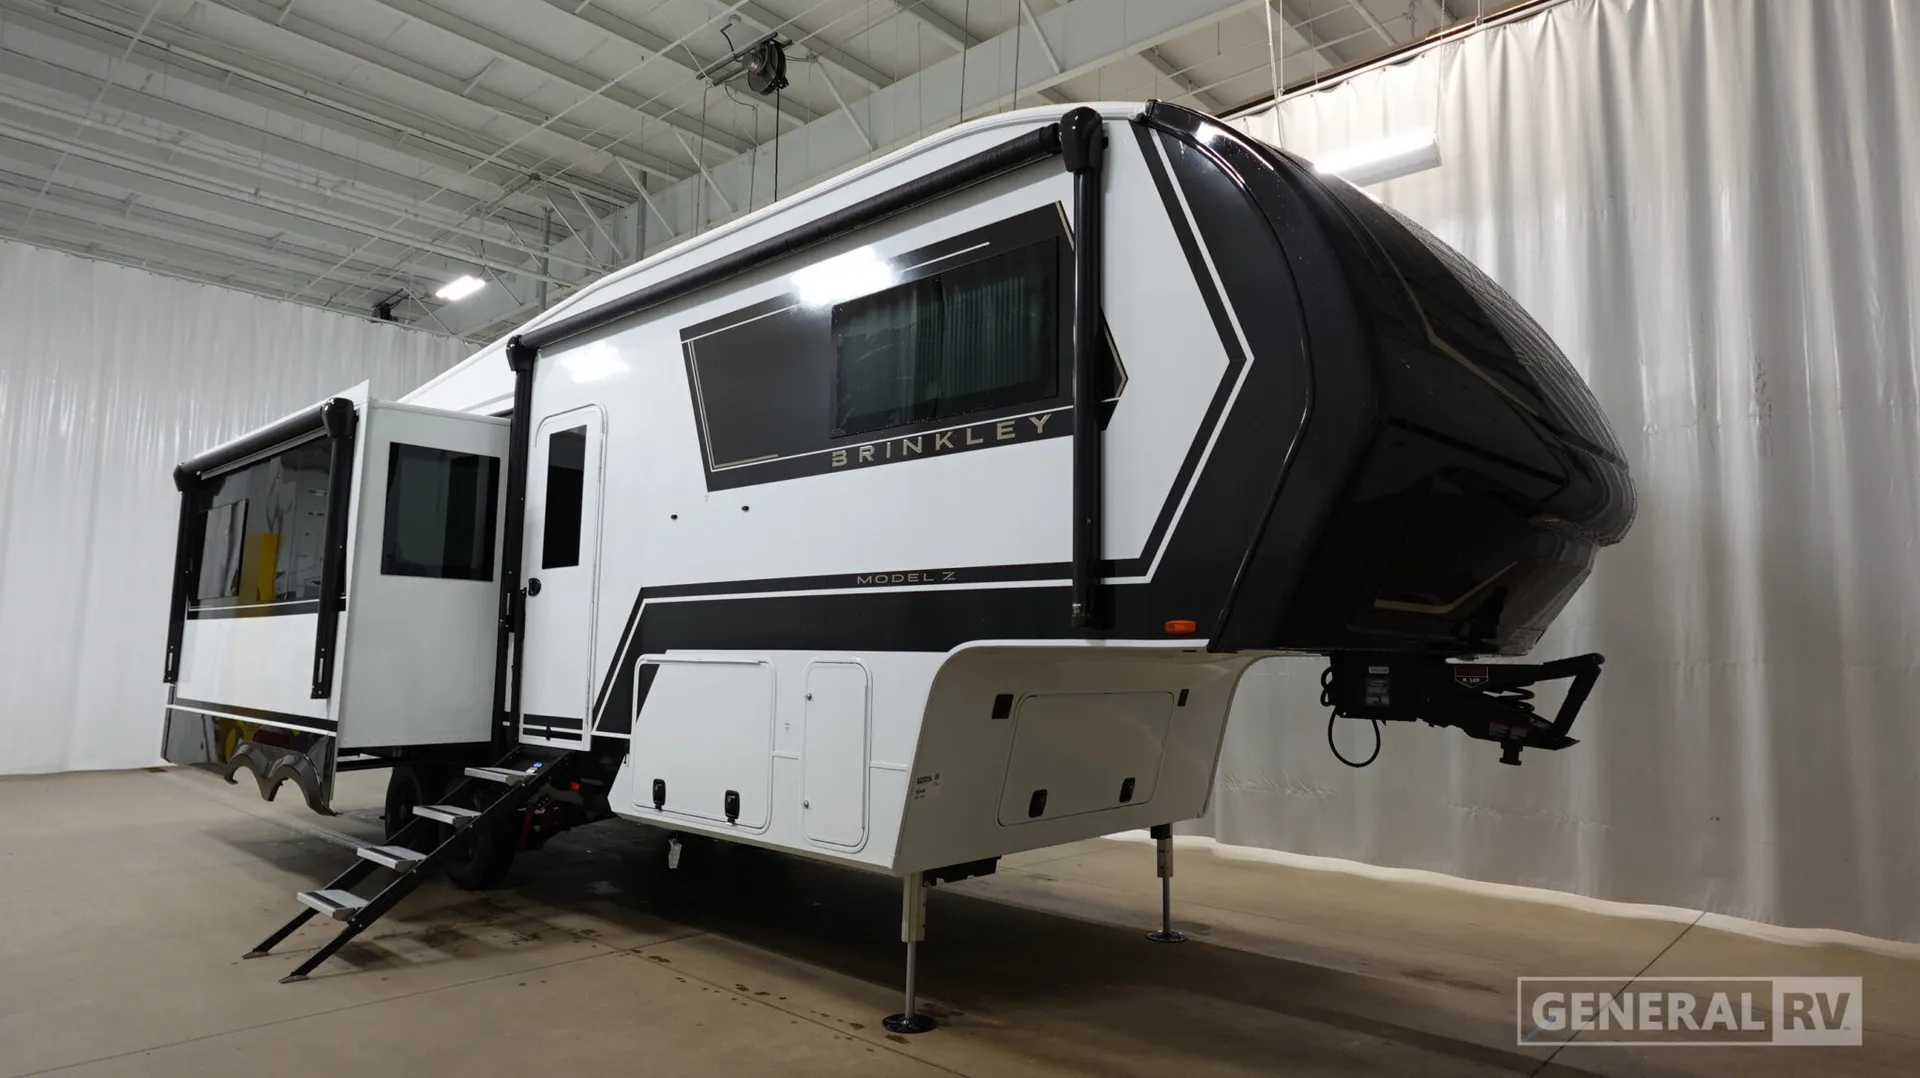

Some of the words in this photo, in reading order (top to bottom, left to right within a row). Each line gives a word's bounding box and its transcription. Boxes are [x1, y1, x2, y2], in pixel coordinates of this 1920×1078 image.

[832, 414, 1051, 468] BRINKLEY
[857, 573, 934, 585] MODEL
[942, 571, 956, 581] Z
